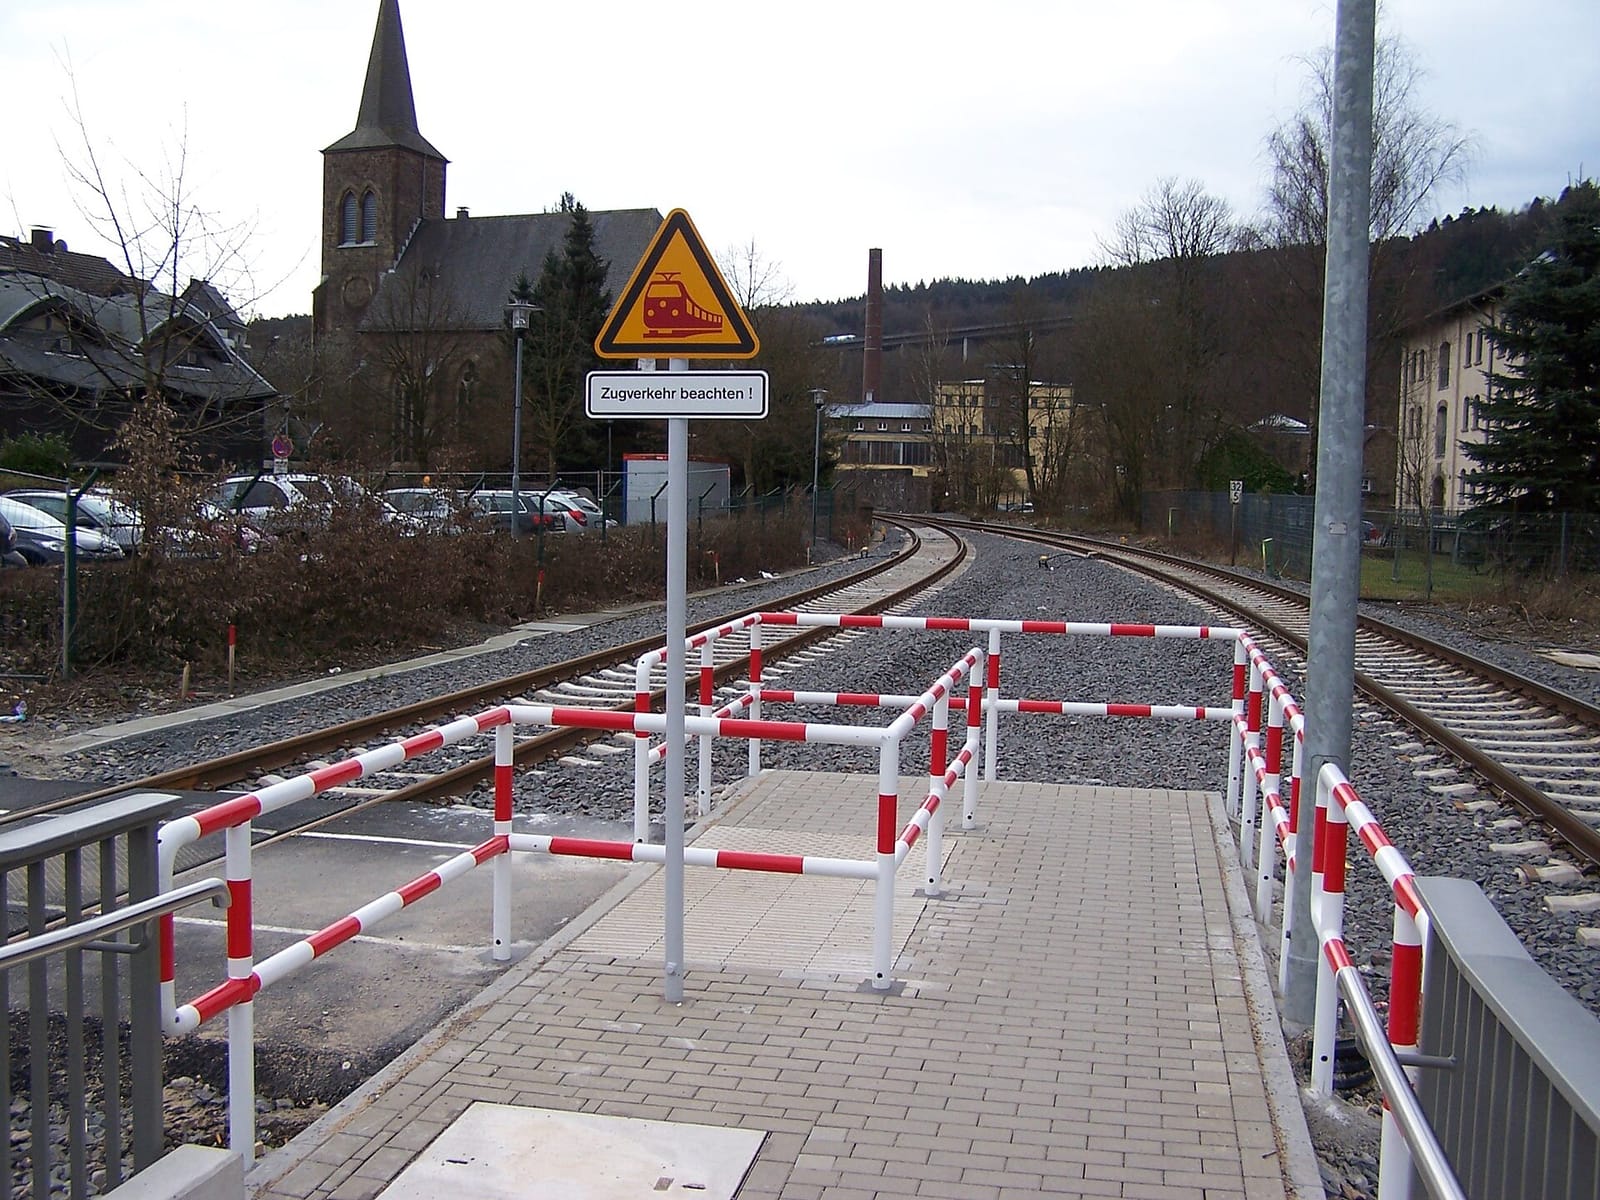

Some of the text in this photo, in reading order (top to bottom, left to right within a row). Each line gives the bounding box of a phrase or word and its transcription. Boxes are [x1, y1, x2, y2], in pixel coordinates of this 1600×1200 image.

[600, 387, 754, 402] Zugverkehr beachten !
[1231, 482, 1242, 491] 32
[1233, 491, 1240, 501] 5
